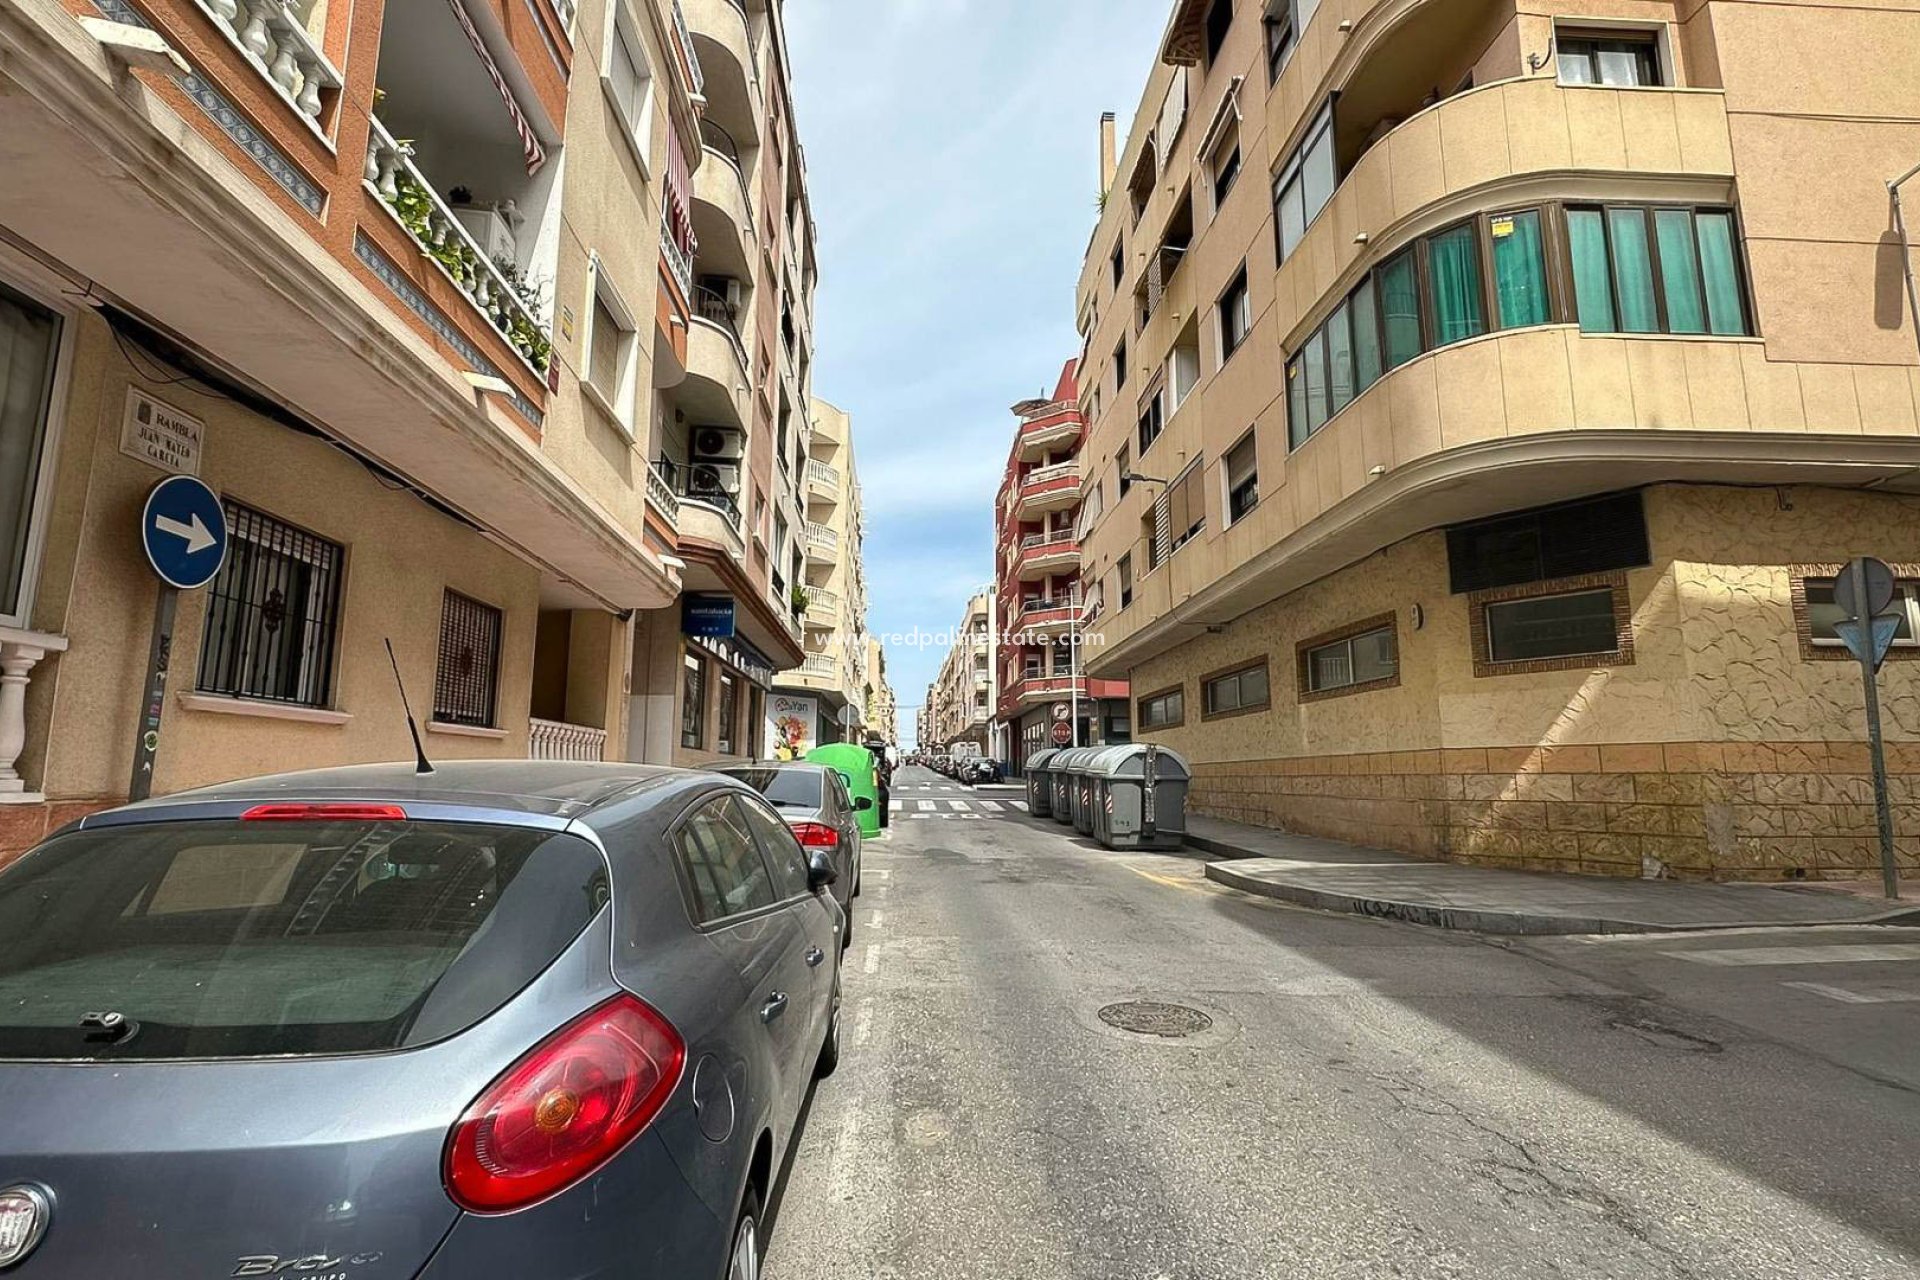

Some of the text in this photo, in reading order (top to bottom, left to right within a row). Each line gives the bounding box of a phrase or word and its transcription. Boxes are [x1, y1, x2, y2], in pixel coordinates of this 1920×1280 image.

[138, 427, 190, 458] JUAN MATEO
[156, 413, 198, 442] RAMBLA
